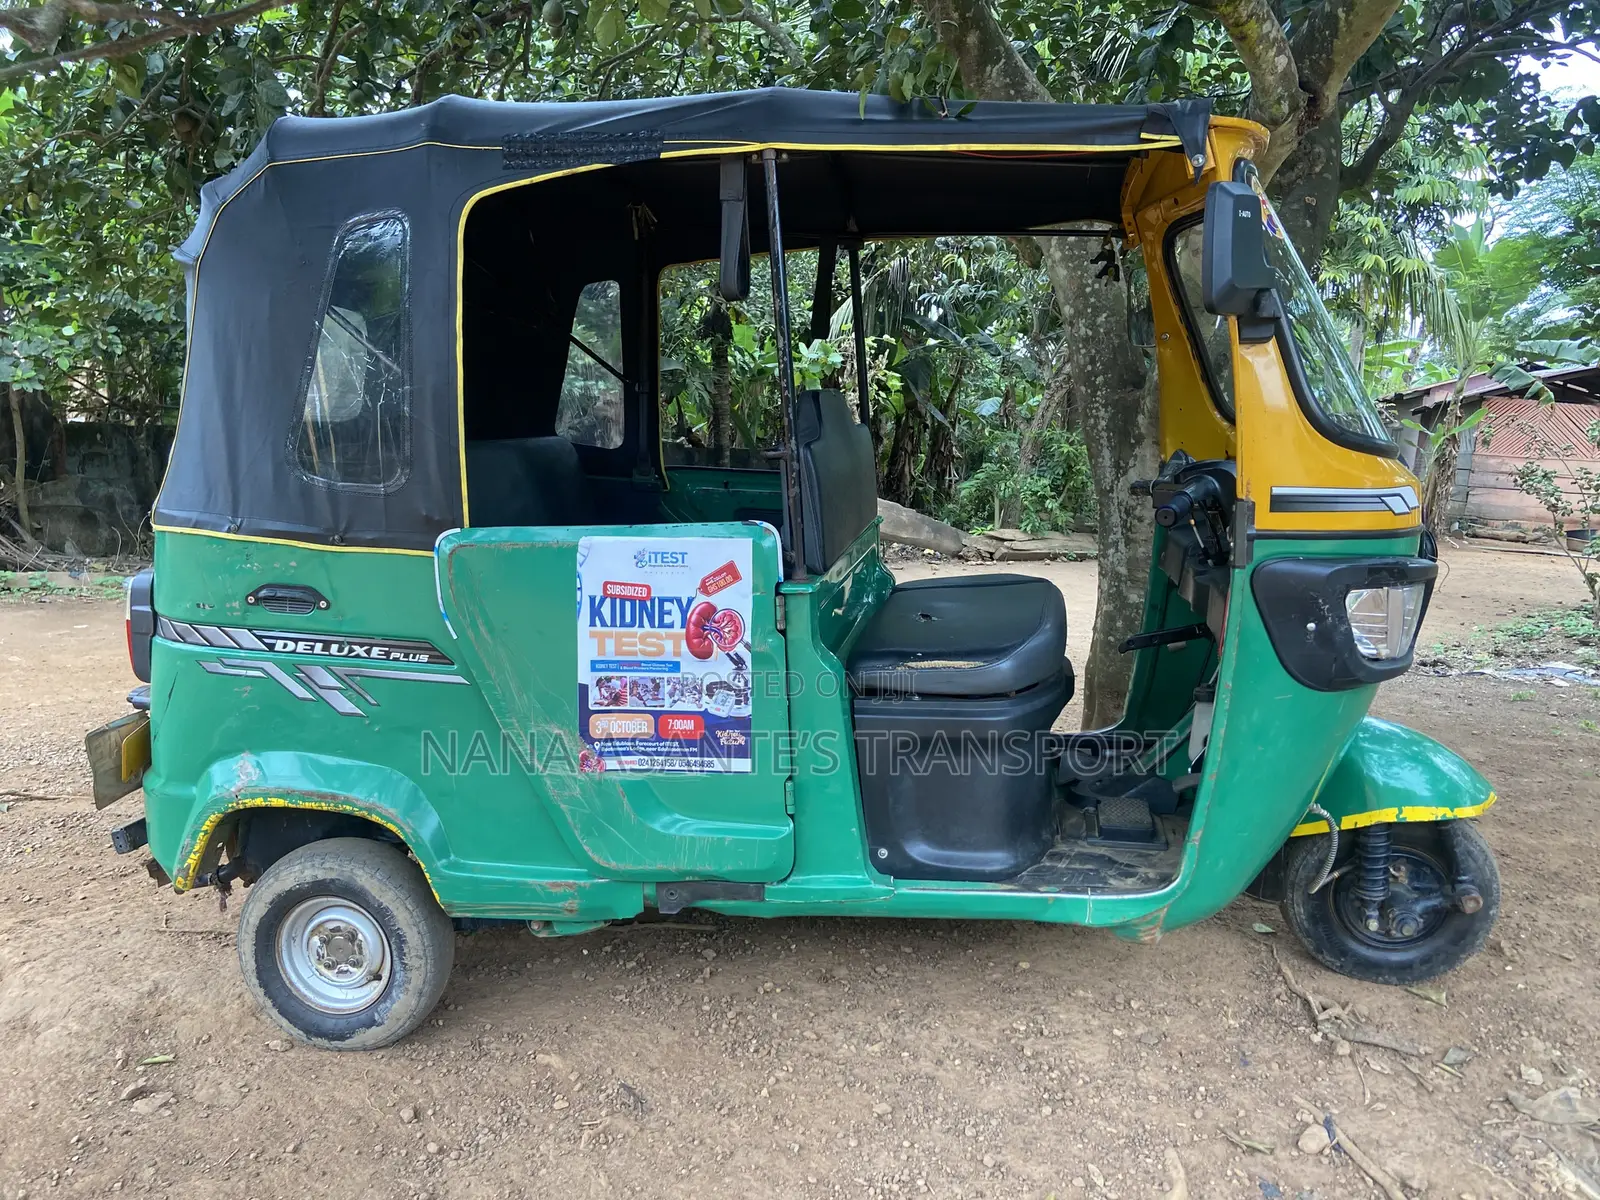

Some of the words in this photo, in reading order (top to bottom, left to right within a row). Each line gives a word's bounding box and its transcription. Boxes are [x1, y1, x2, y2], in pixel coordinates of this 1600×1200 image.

[606, 584, 648, 598] SUBSIDIZED
[588, 595, 696, 630] KIDNEY
[274, 639, 390, 659] DELUXE
[389, 652, 430, 663] PLUS
[588, 630, 687, 658] TEST
[609, 720, 648, 733] OCTOBER
[667, 719, 695, 730] 7:00AM
